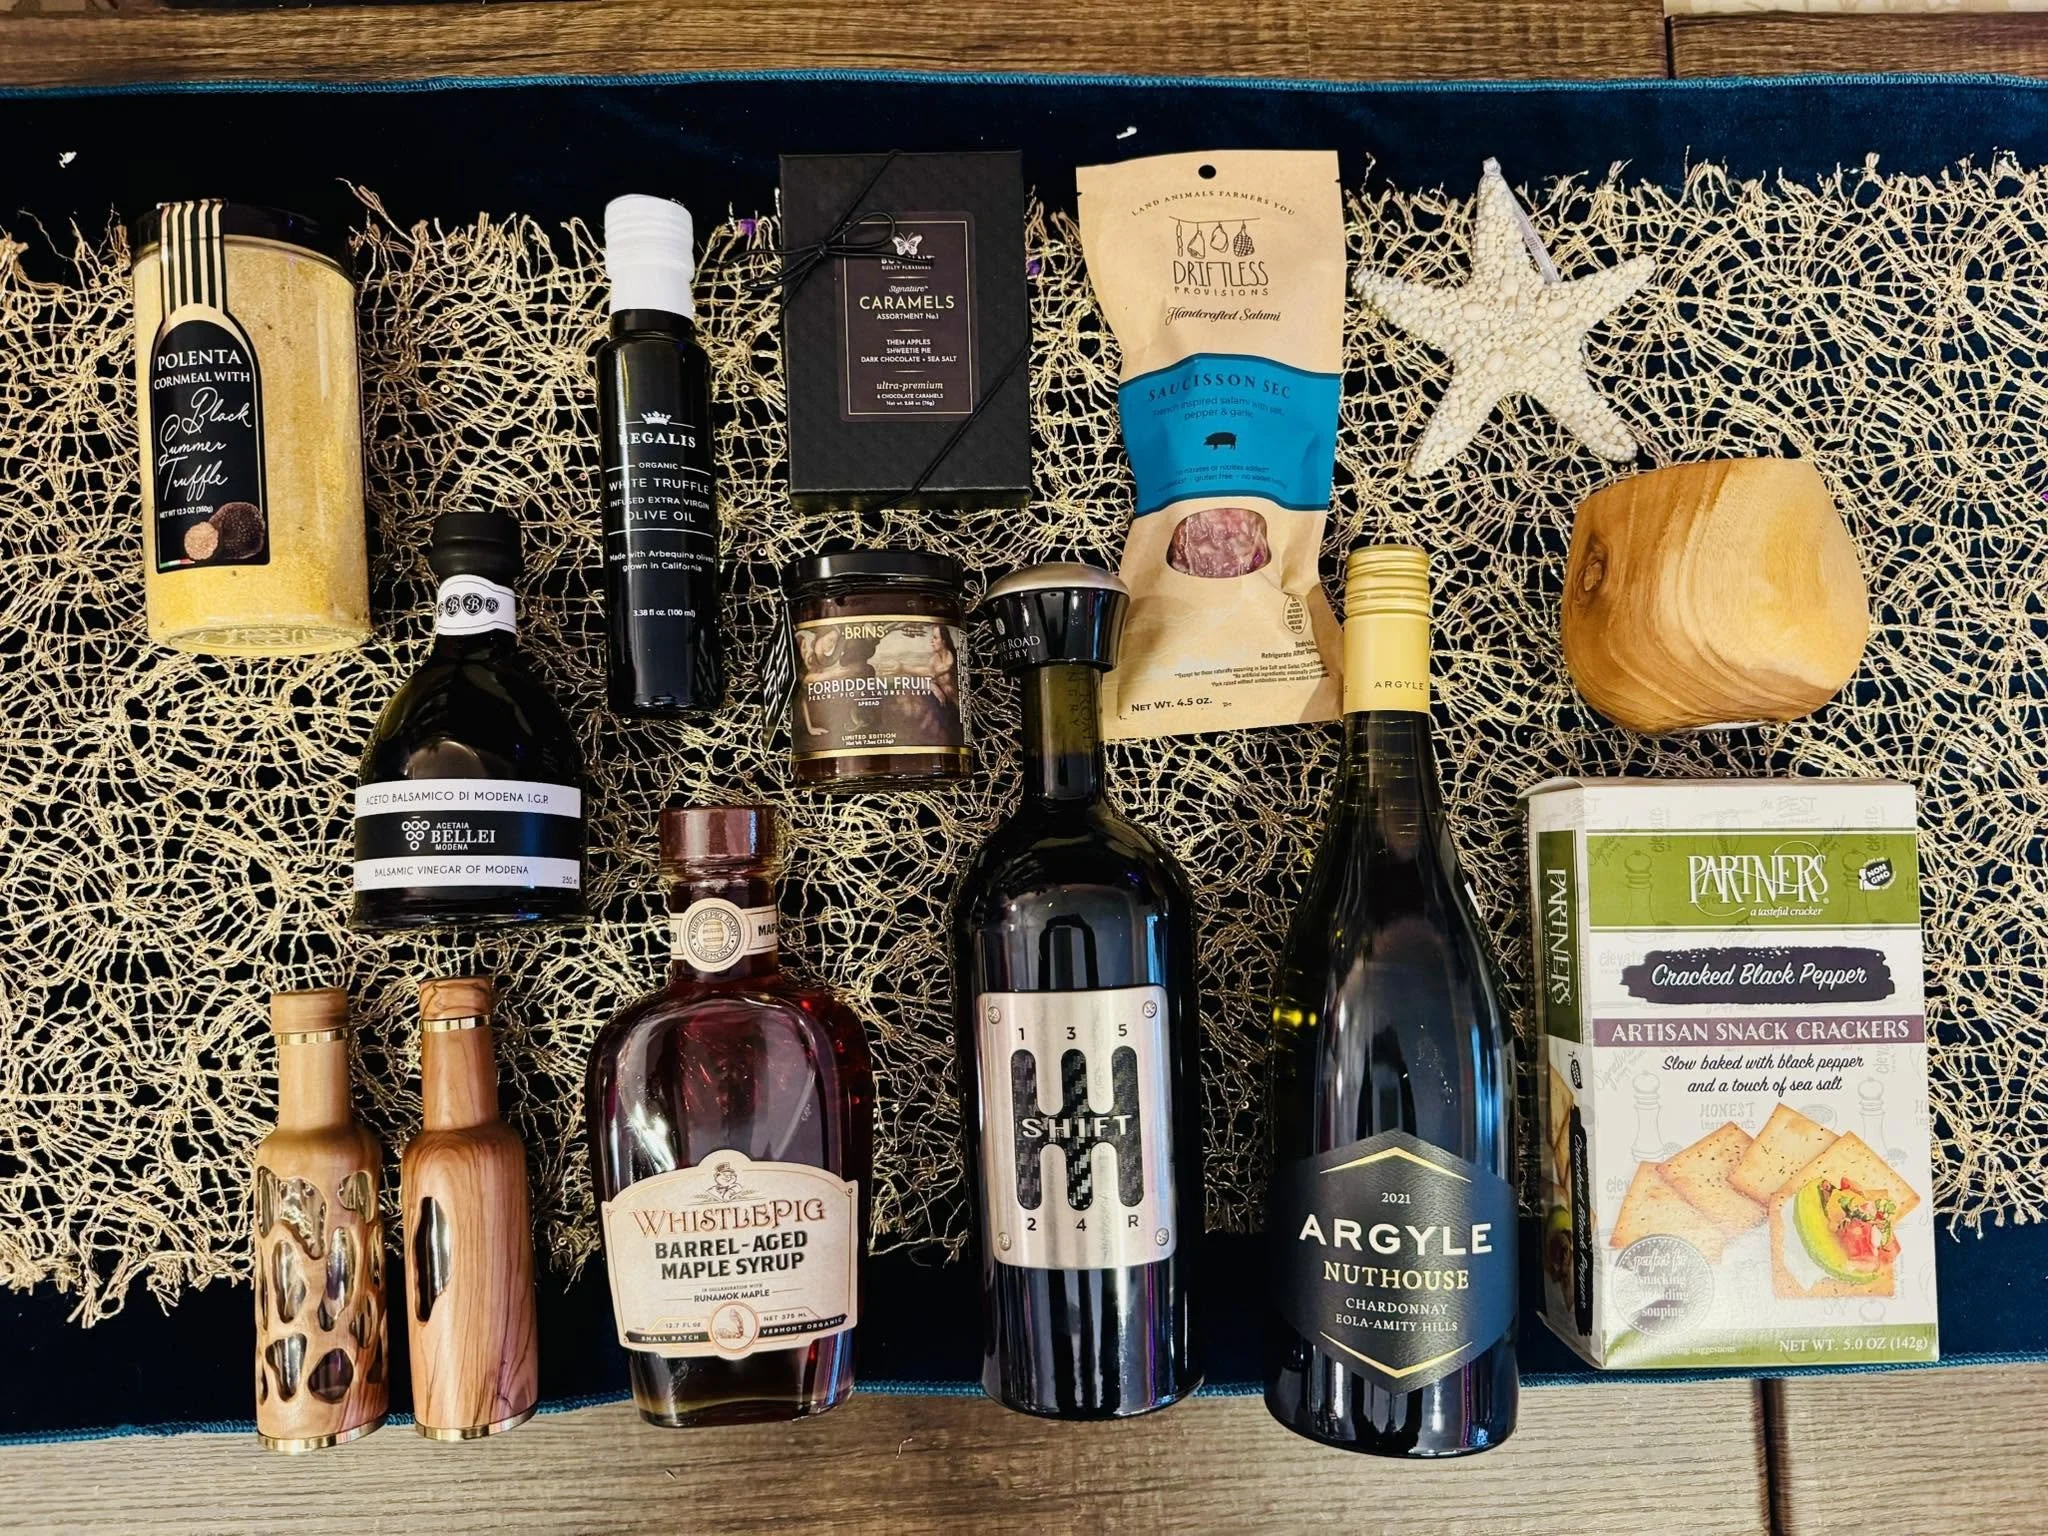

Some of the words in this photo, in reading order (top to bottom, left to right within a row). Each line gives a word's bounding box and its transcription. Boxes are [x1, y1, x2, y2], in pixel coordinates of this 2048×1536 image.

[1131, 199, 1160, 217] LAND
[1165, 190, 1214, 203] ANIMALS
[1219, 191, 1268, 205] FARMERS
[1274, 202, 1295, 216] YOU
[1173, 260, 1269, 287] DRIFTLESS
[1174, 286, 1269, 296] PROVISIONS
[860, 296, 955, 310] CARAMELS
[1165, 306, 1239, 326] Handcrafted
[1239, 308, 1281, 321] Salumi
[158, 349, 242, 371] POLENTA
[154, 372, 212, 390] CORNMEAL
[214, 371, 251, 382] WITH
[876, 380, 943, 391] ultra-premium
[1148, 373, 1255, 401] SAUCISSON
[1263, 380, 1290, 399] SEC
[181, 386, 252, 435] Black
[1184, 408, 1216, 421] pepper
[159, 414, 227, 467] Summer
[639, 462, 678, 470] ORGANIC
[158, 456, 229, 502] Truffle
[609, 478, 648, 492] WHTE
[653, 478, 709, 495] TRUFFLE
[187, 506, 196, 514] OZ
[648, 496, 681, 505] EXTRA
[684, 498, 710, 510] VIRGIN
[626, 510, 668, 521] OLIVE
[673, 511, 696, 523] OIL
[648, 550, 694, 559] Arbequina
[661, 562, 702, 572] California
[633, 609, 648, 617] 3.38
[667, 609, 683, 617] (100
[808, 677, 888, 696] FORBIDDEN
[894, 676, 932, 690] FRUIT
[1374, 680, 1424, 691] ARGYLE
[1177, 697, 1194, 707] 4.5
[868, 732, 897, 740] EDITION
[366, 794, 389, 805] ACETO
[391, 791, 455, 802] BALSAMICO
[459, 791, 470, 801] DI
[474, 791, 524, 802] MODENA
[527, 793, 549, 805] I.G.P.
[436, 821, 470, 830] ACETAIA
[430, 829, 496, 844] BELLEI
[435, 843, 469, 851] MODENA
[374, 866, 414, 878] BALSAMIC
[417, 864, 462, 875] VINEGAR
[466, 864, 480, 874] OF
[485, 864, 529, 875] MODENA
[1687, 853, 1829, 904] PARTNERS
[1866, 863, 1887, 878] NON
[1870, 870, 1890, 884] GMO
[1758, 906, 1789, 918] tasteful
[1790, 906, 1823, 916] cracker
[1651, 962, 1736, 986] Cracked
[1738, 962, 1796, 985] Black
[1799, 962, 1867, 990] Pepper
[1018, 1027, 1025, 1041] 1
[1066, 1026, 1076, 1040] 3
[1118, 1023, 1128, 1037] 5
[1612, 1023, 1708, 1042] ARTISAN
[1716, 1022, 1789, 1041] SNACK
[1796, 1019, 1909, 1040] CRACKERS
[1662, 1055, 1697, 1071] Slow
[1700, 1054, 1744, 1070] baked
[1745, 1055, 1775, 1069] with
[1777, 1053, 1814, 1069] black
[1815, 1055, 1864, 1073] pepper
[1687, 1078, 1715, 1093] and
[1718, 1082, 1729, 1093] a
[1732, 1076, 1769, 1092] touch
[1772, 1076, 1788, 1098] of
[1789, 1081, 1813, 1092] sea
[1816, 1075, 1842, 1091] salt
[1022, 1114, 1132, 1138] SHIFT
[1381, 1192, 1412, 1205] 2021
[631, 1198, 826, 1239] WHISTLEPIG
[1027, 1217, 1037, 1231] 2
[1075, 1217, 1087, 1231] 4
[1128, 1214, 1140, 1228] R
[1299, 1213, 1493, 1256] ARGYLE
[661, 1256, 731, 1281] MAPLE
[736, 1252, 805, 1276] SYRUP
[1323, 1260, 1469, 1291] NUTHOUSE
[694, 1292, 739, 1303] RUNAMOK
[740, 1289, 770, 1299] MAPLE
[1345, 1297, 1449, 1316] CHARDONNAY
[1641, 1304, 1685, 1320] souping
[762, 1324, 803, 1336] VERMONT
[806, 1316, 844, 1330] ORGANIC
[763, 1314, 779, 1322] NET
[1335, 1313, 1417, 1332] EOLA-AMITY
[1422, 1320, 1458, 1333] HILLS
[641, 1335, 669, 1343] SMALL
[671, 1334, 700, 1342] BATCH
[1779, 1339, 1809, 1352] NET
[1813, 1338, 1838, 1351] WT.
[1843, 1337, 1863, 1350] 5.0
[1866, 1337, 1887, 1350] OZ
[1890, 1336, 1929, 1351] (142g)
